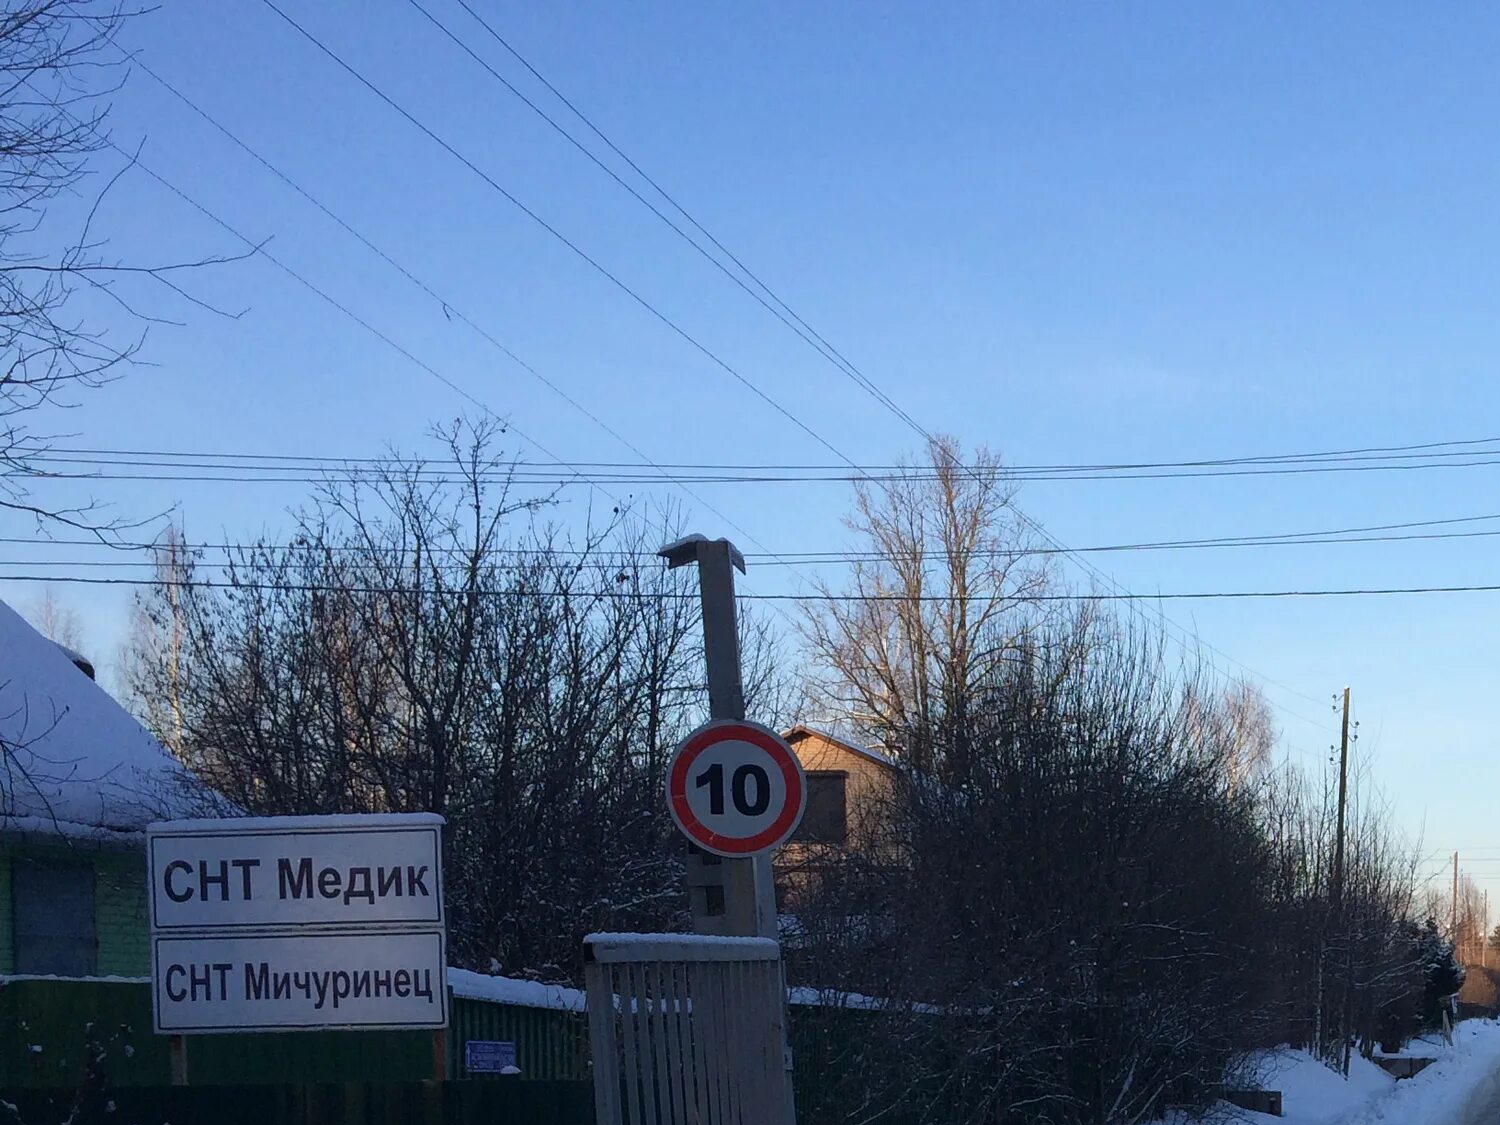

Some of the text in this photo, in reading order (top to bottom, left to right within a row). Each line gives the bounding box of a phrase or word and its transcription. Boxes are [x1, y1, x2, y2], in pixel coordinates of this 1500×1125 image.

[695, 763, 771, 817] 10
[164, 858, 430, 905] СНТ Медик
[165, 962, 433, 1009] СНТ Мичуринец
